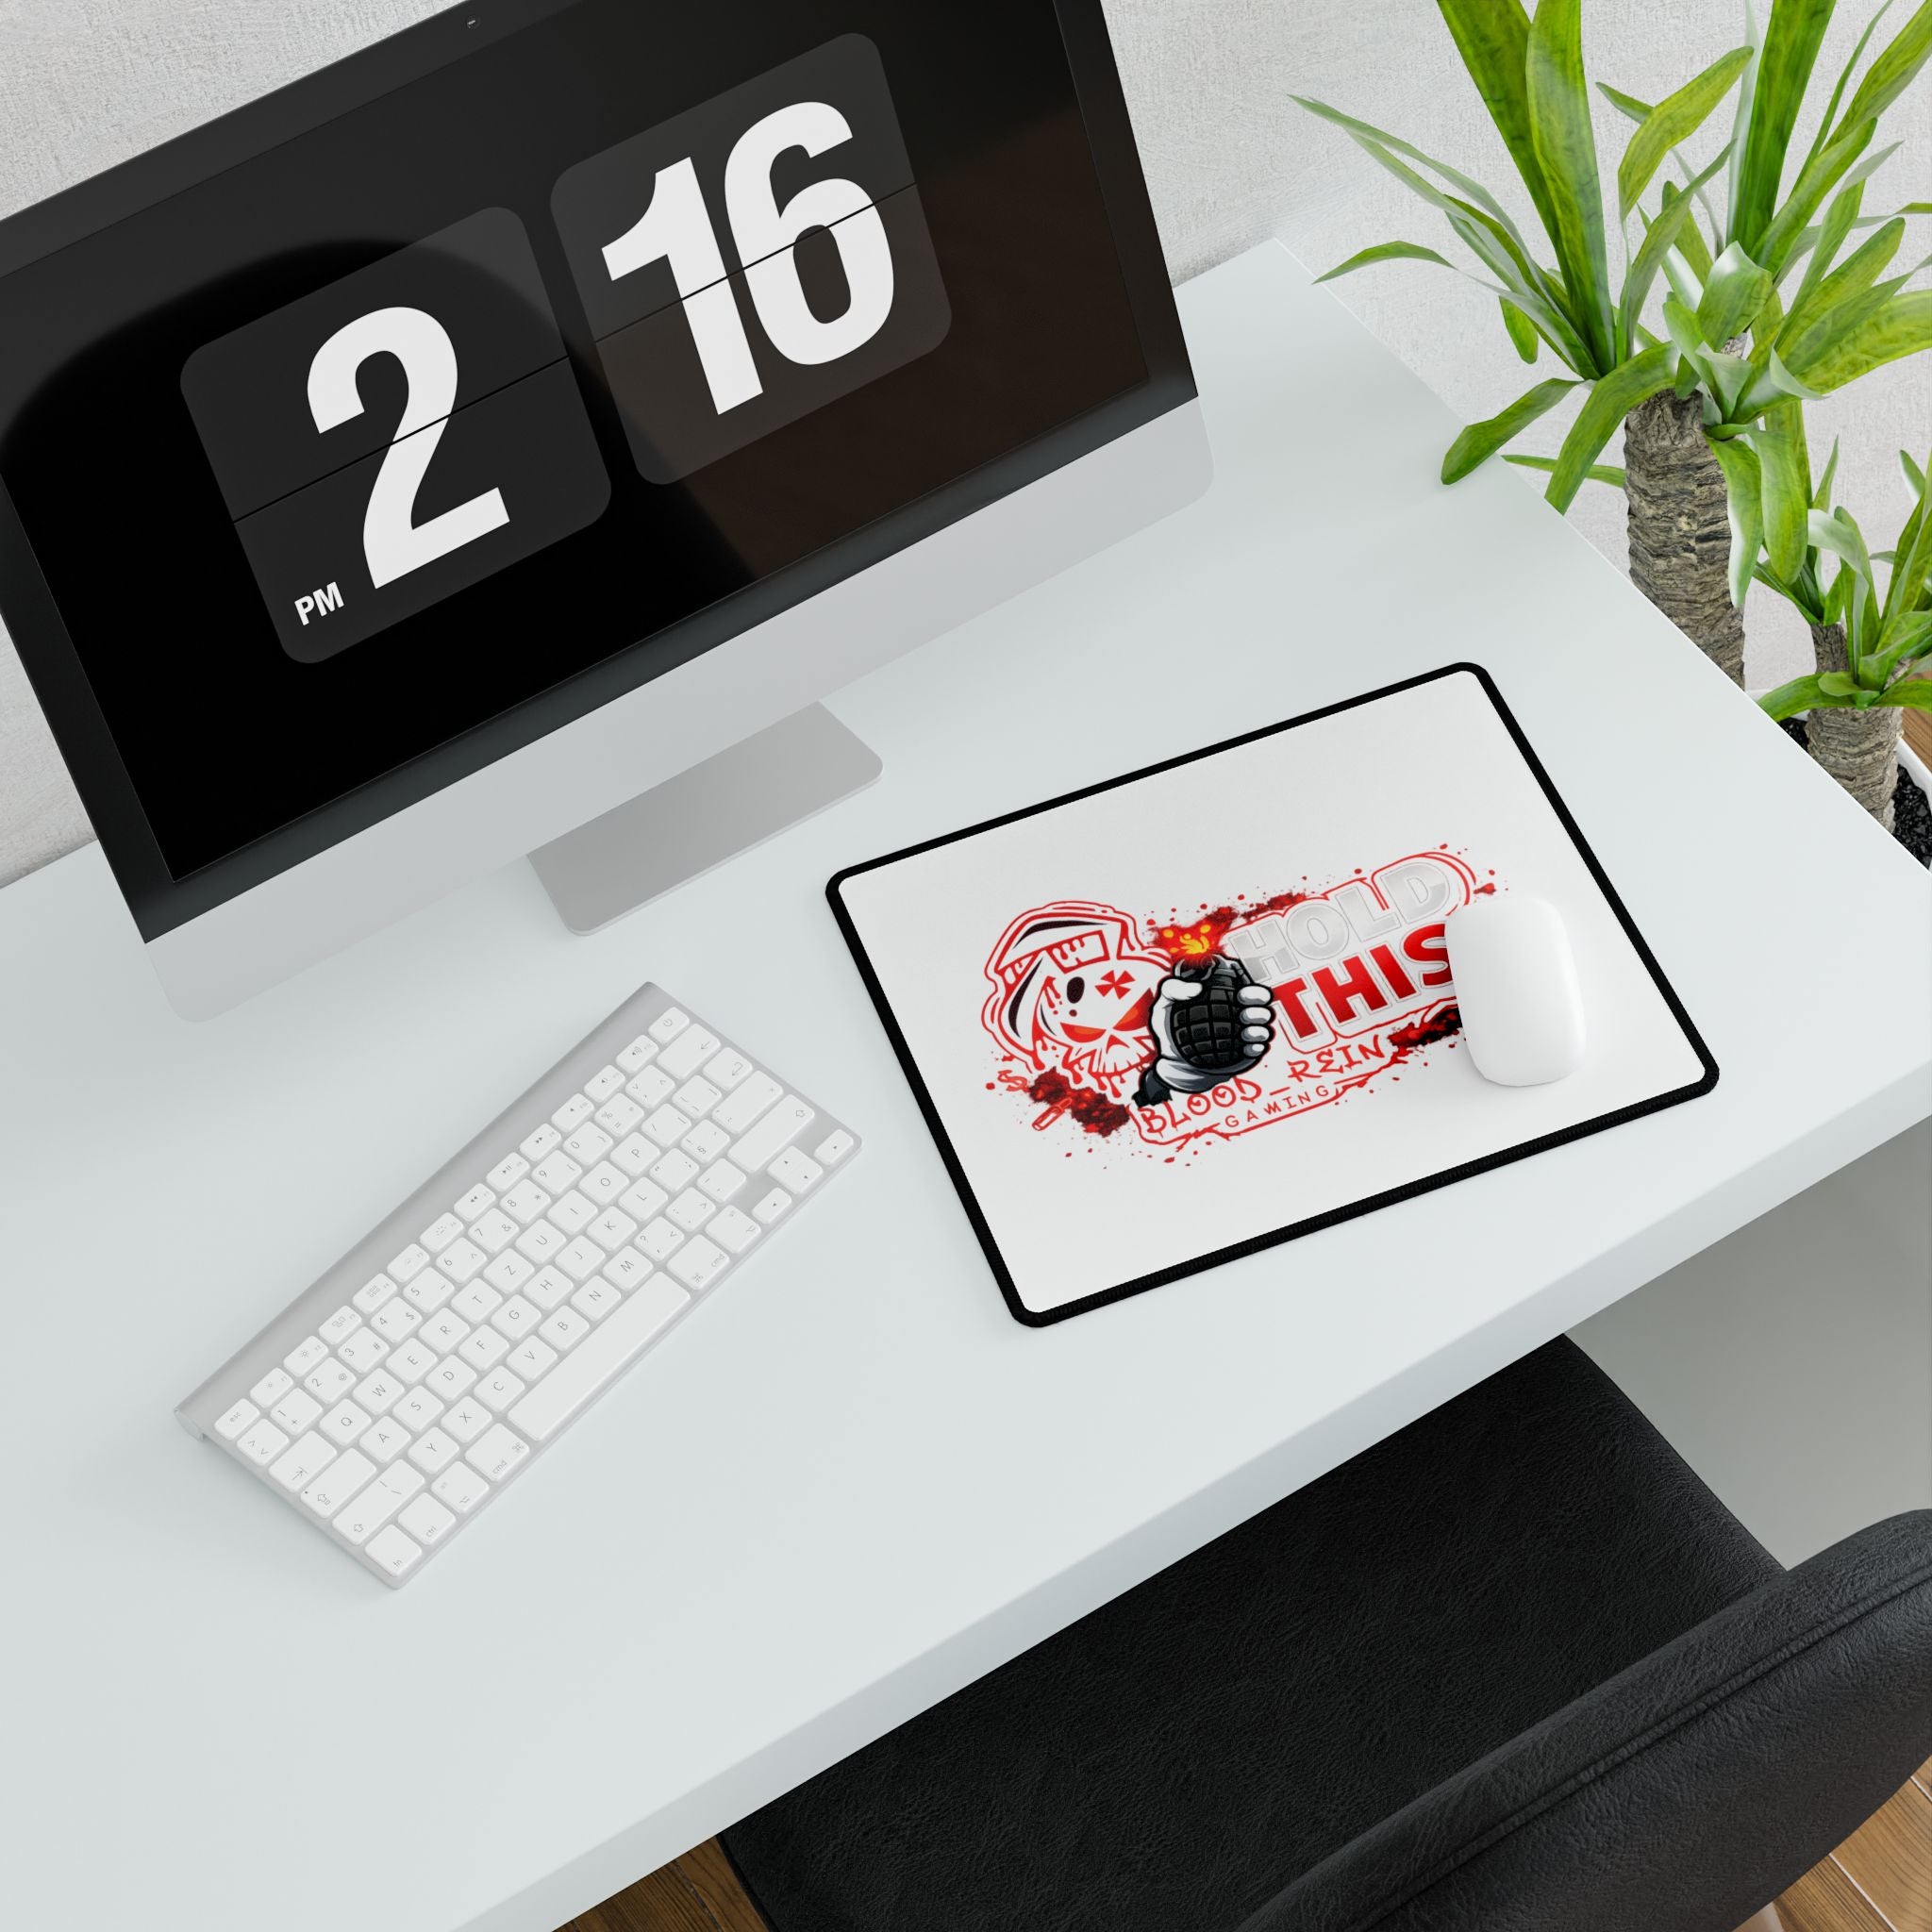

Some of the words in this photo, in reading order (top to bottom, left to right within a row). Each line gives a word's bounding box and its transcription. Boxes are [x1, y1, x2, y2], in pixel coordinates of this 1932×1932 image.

[602, 102, 894, 415] 16
[307, 307, 509, 589] 2
[294, 581, 344, 625] PM
[1230, 861, 1451, 983] HOLD
[1272, 923, 1454, 1040] THIS
[1224, 1085, 1329, 1128] GAMING
[341, 1417, 353, 1426] Q
[372, 1384, 387, 1397] W
[407, 1356, 419, 1366] E
[440, 1325, 450, 1335] R
[472, 1295, 482, 1304] T
[504, 1264, 516, 1276] Z
[535, 1235, 548, 1246] U
[599, 1177, 611, 1188] O
[630, 1148, 640, 1158] P
[377, 1433, 390, 1443] A
[409, 1401, 422, 1411] S
[442, 1371, 455, 1382] D
[475, 1340, 485, 1350] F
[508, 1309, 521, 1321] G
[540, 1279, 553, 1291] H
[575, 1250, 584, 1260] J
[605, 1222, 615, 1231] K
[636, 1193, 647, 1202] L
[425, 1442, 437, 1452] Y
[459, 1412, 472, 1423] X
[492, 1381, 505, 1391] C
[525, 1350, 536, 1360] V
[557, 1321, 569, 1331] B
[588, 1290, 602, 1302] N
[620, 1260, 634, 1273] M
